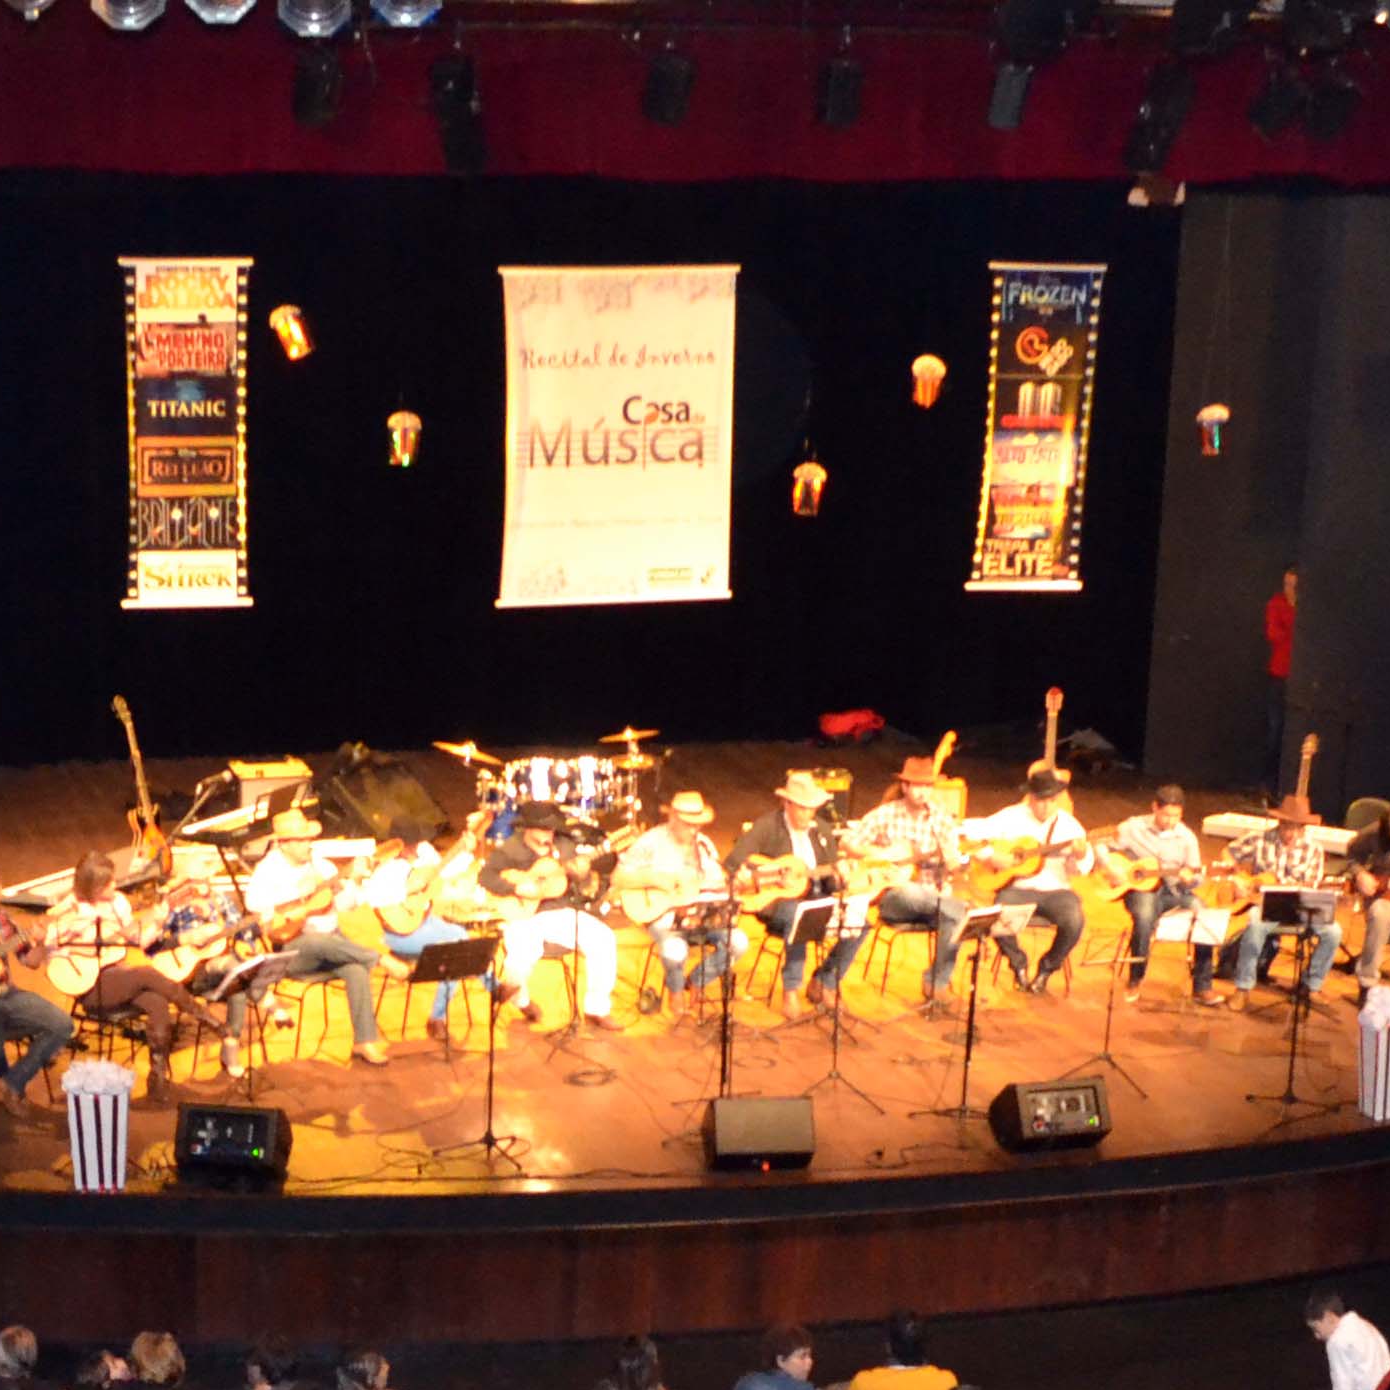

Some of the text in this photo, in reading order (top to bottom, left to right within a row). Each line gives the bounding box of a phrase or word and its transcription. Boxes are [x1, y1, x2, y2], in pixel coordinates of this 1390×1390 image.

[1007, 281, 1087, 305] FROZEN
[156, 331, 224, 350] MENINO
[158, 350, 226, 370] PORTEIRA
[522, 341, 716, 369] Recital de Inverno
[147, 399, 226, 418] TITANIC
[622, 395, 691, 426] Casa
[528, 416, 705, 471] Música
[982, 553, 1053, 577] ELITE
